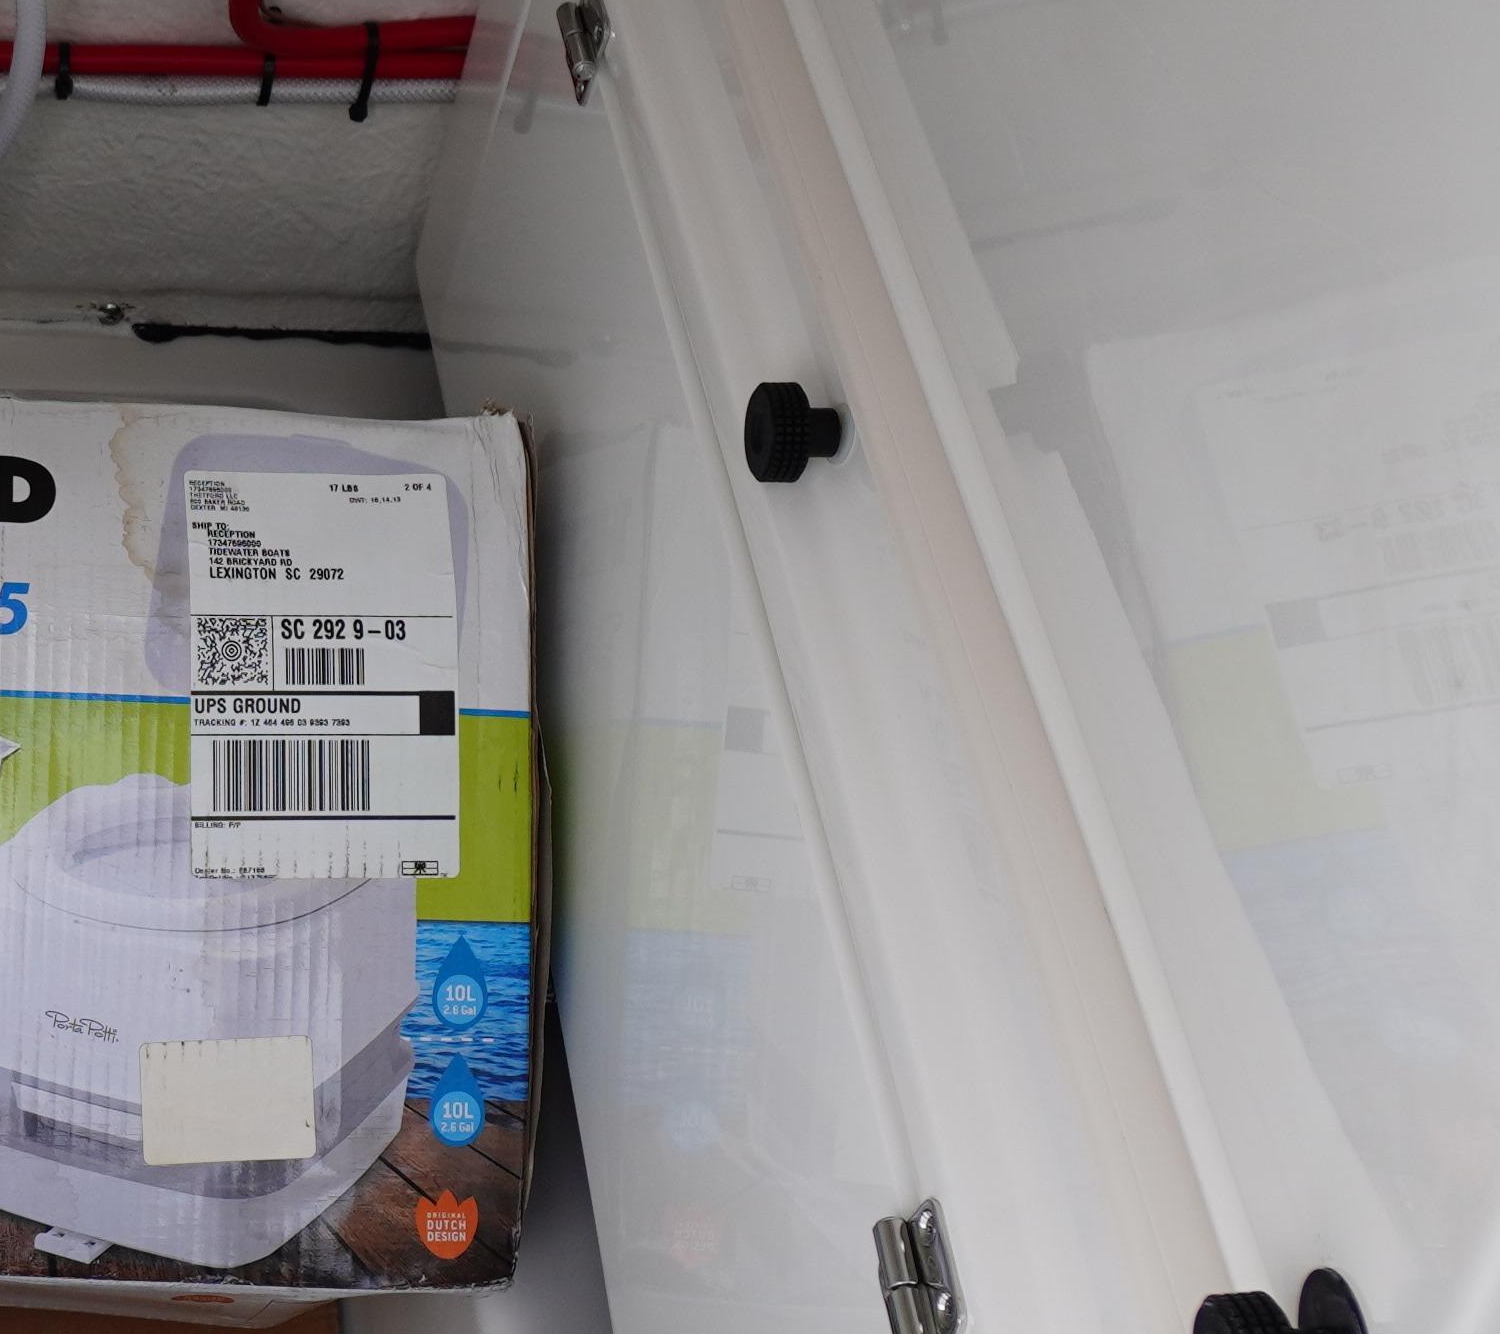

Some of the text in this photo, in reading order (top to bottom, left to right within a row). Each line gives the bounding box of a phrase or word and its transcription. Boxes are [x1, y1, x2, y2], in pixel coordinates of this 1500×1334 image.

[329, 484, 338, 492] 17
[404, 483, 433, 491] 2 OF 4
[192, 521, 213, 529] SHIP
[207, 529, 256, 538] RECEPTION
[209, 547, 291, 557] TIDEWATER BOATS
[209, 557, 293, 566] 142 BRICKYARD RD
[209, 567, 344, 580] LEXINGTON SC 29072
[281, 618, 305, 640] SC
[312, 618, 346, 640] 292
[194, 698, 300, 714] UPS GROUND
[194, 718, 236, 727] TRACKING
[445, 984, 476, 1001] 10L
[461, 1004, 477, 1015] Gal
[45, 1010, 83, 1034] Porta
[443, 1101, 474, 1119] 10L
[459, 1121, 475, 1133] Gal
[427, 1219, 466, 1230] DUTCH
[427, 1231, 466, 1242] DESIGN
